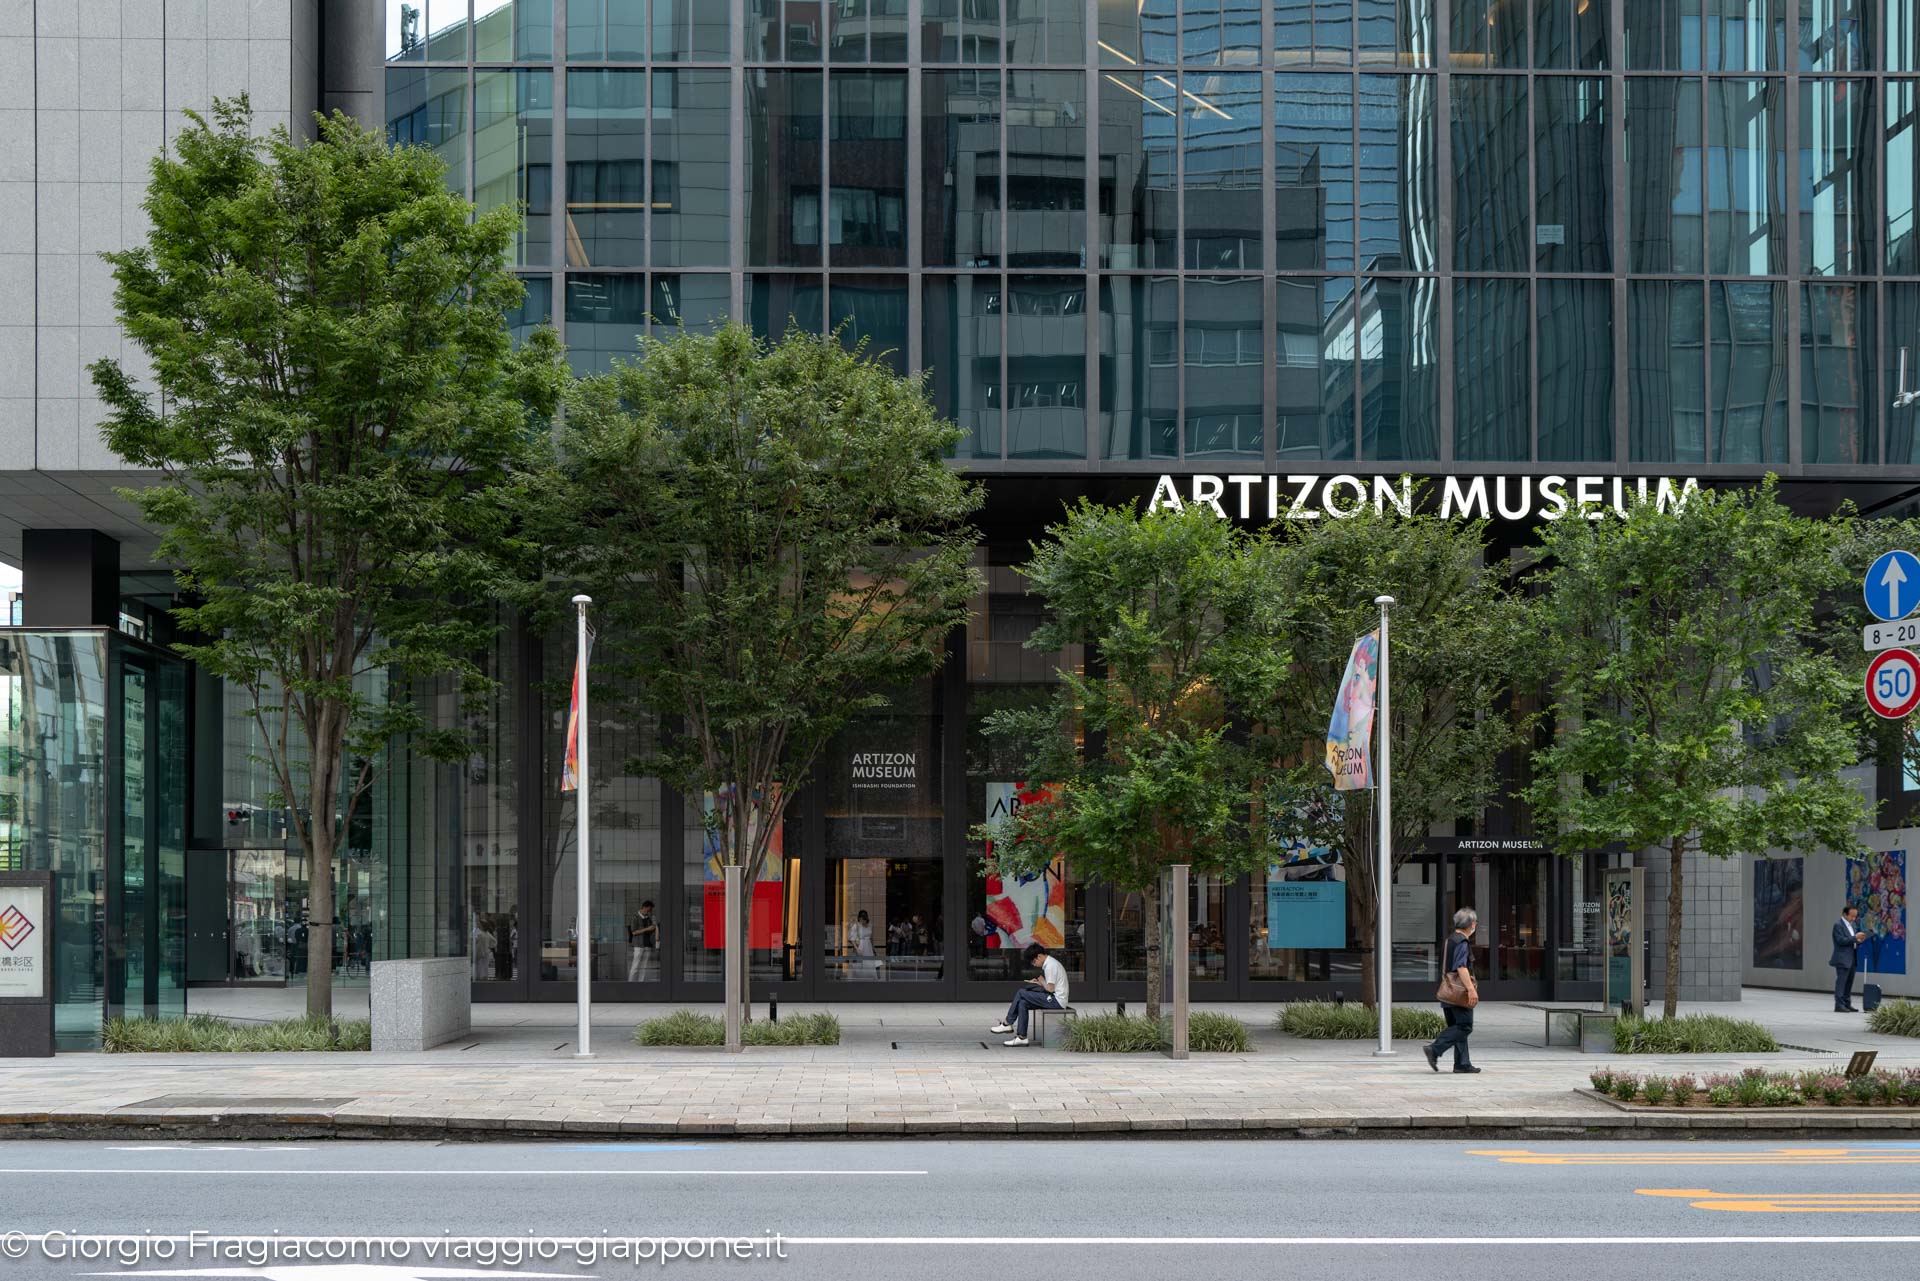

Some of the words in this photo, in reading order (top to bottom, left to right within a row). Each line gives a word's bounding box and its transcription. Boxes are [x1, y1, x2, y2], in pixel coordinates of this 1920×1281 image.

[1148, 474, 1412, 519] ARTIZON
[1440, 475, 1699, 520] MUSEUM
[1878, 667, 1911, 699] 50
[852, 753, 916, 765] ARTIZON
[852, 766, 916, 778] MUSEUM
[1458, 840, 1499, 849] ARTIZON
[0, 956, 33, 967] 橋彩区
